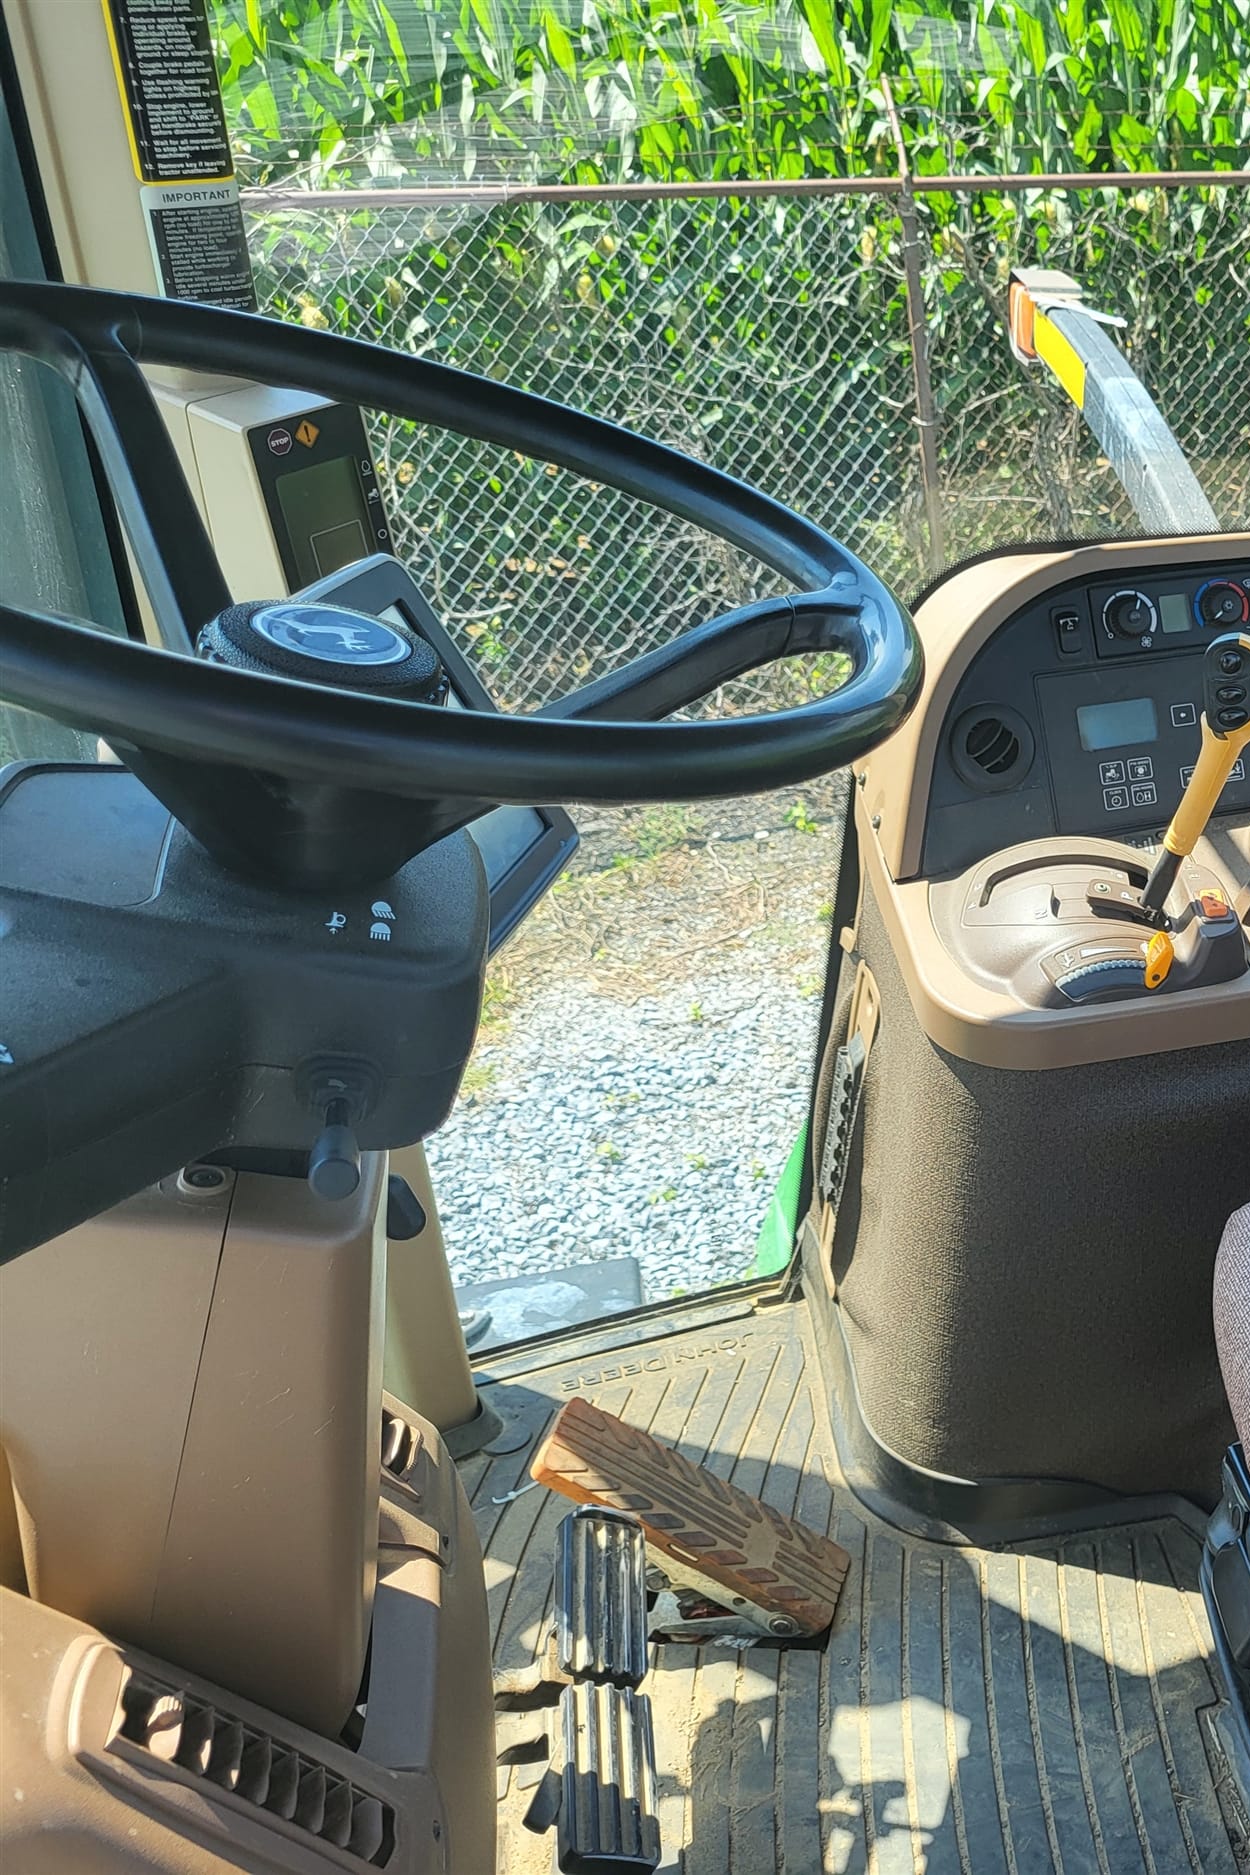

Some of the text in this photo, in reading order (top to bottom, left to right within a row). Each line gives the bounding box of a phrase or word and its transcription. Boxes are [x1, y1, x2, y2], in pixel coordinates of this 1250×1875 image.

[162, 190, 230, 203] IMPORTANT
[271, 436, 288, 447] STOP
[559, 1357, 668, 1392] DEERE
